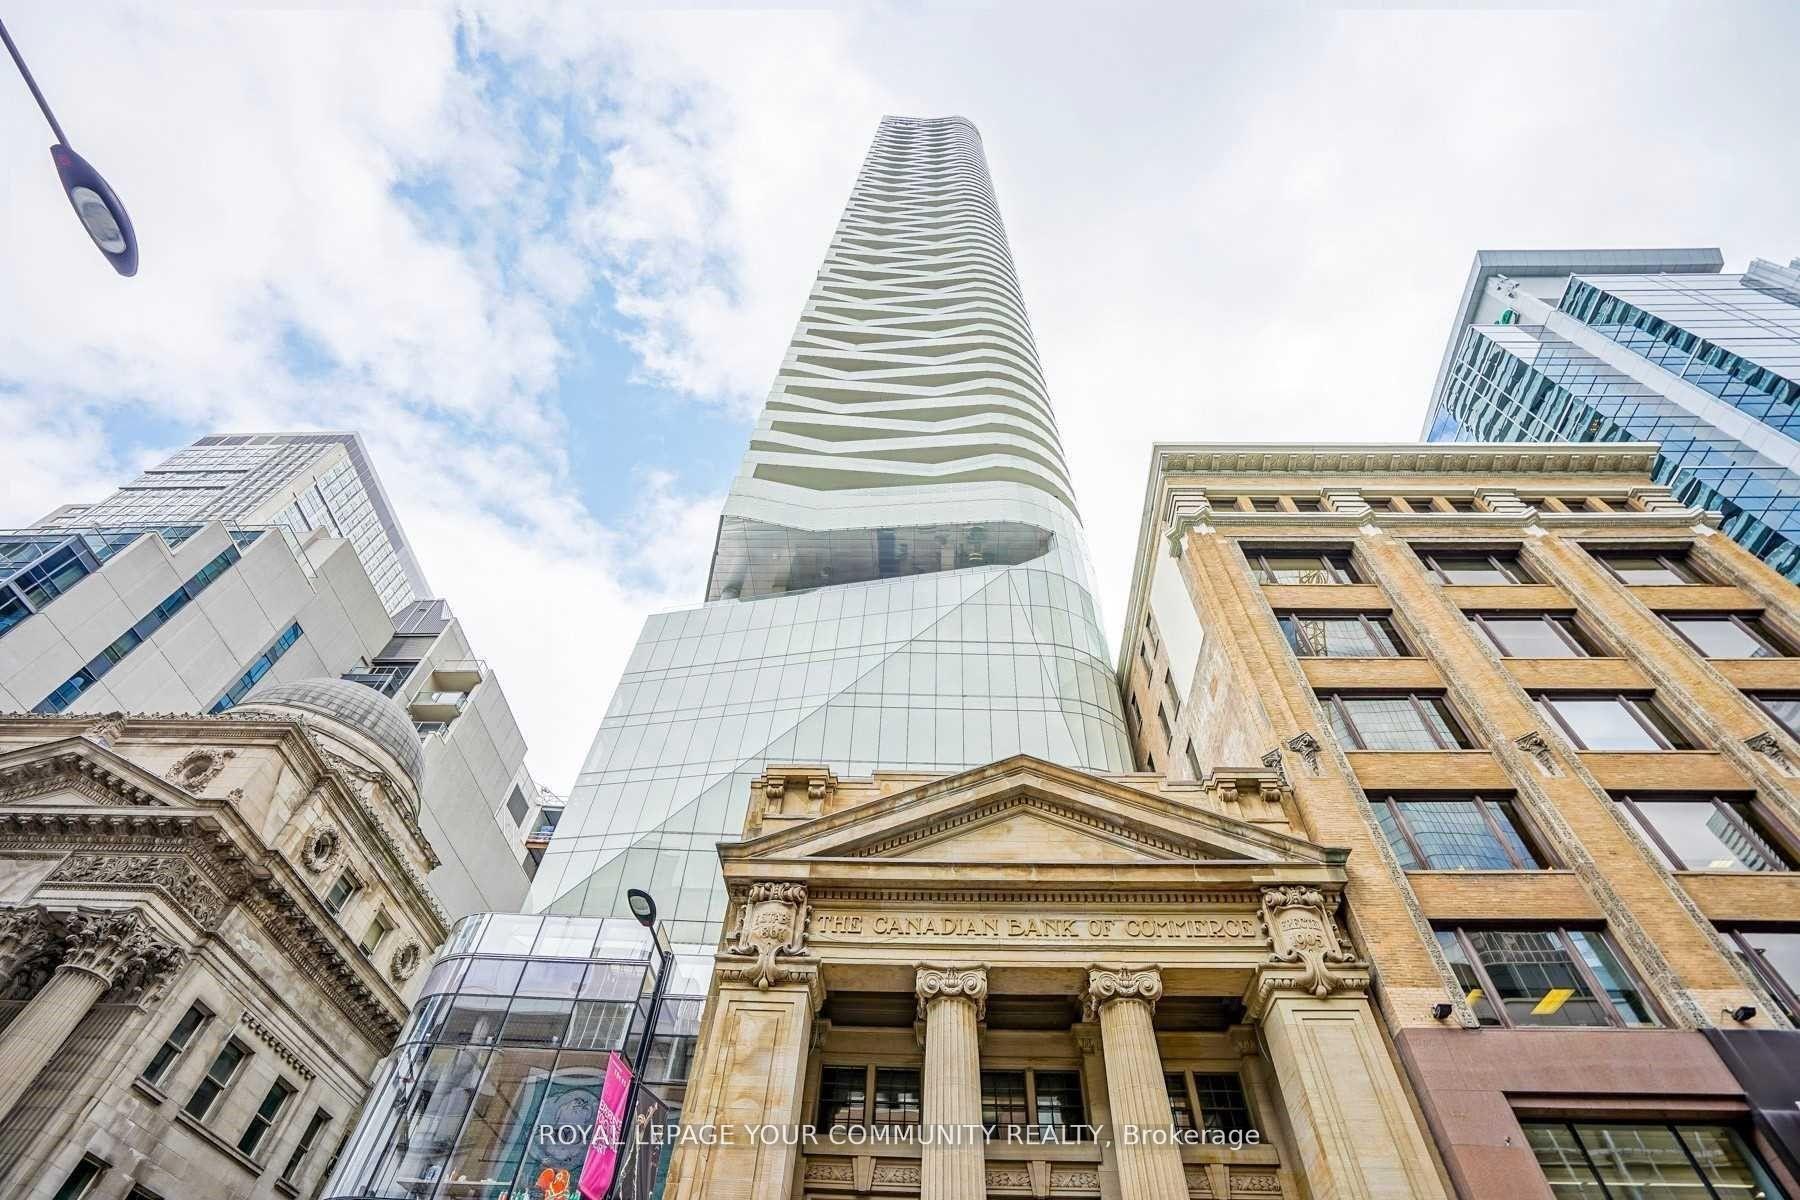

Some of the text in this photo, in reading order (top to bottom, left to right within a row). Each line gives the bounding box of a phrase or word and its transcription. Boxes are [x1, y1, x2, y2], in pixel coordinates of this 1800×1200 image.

[816, 915, 1257, 938] THE CANADIAN BANK OF COMMERCE
